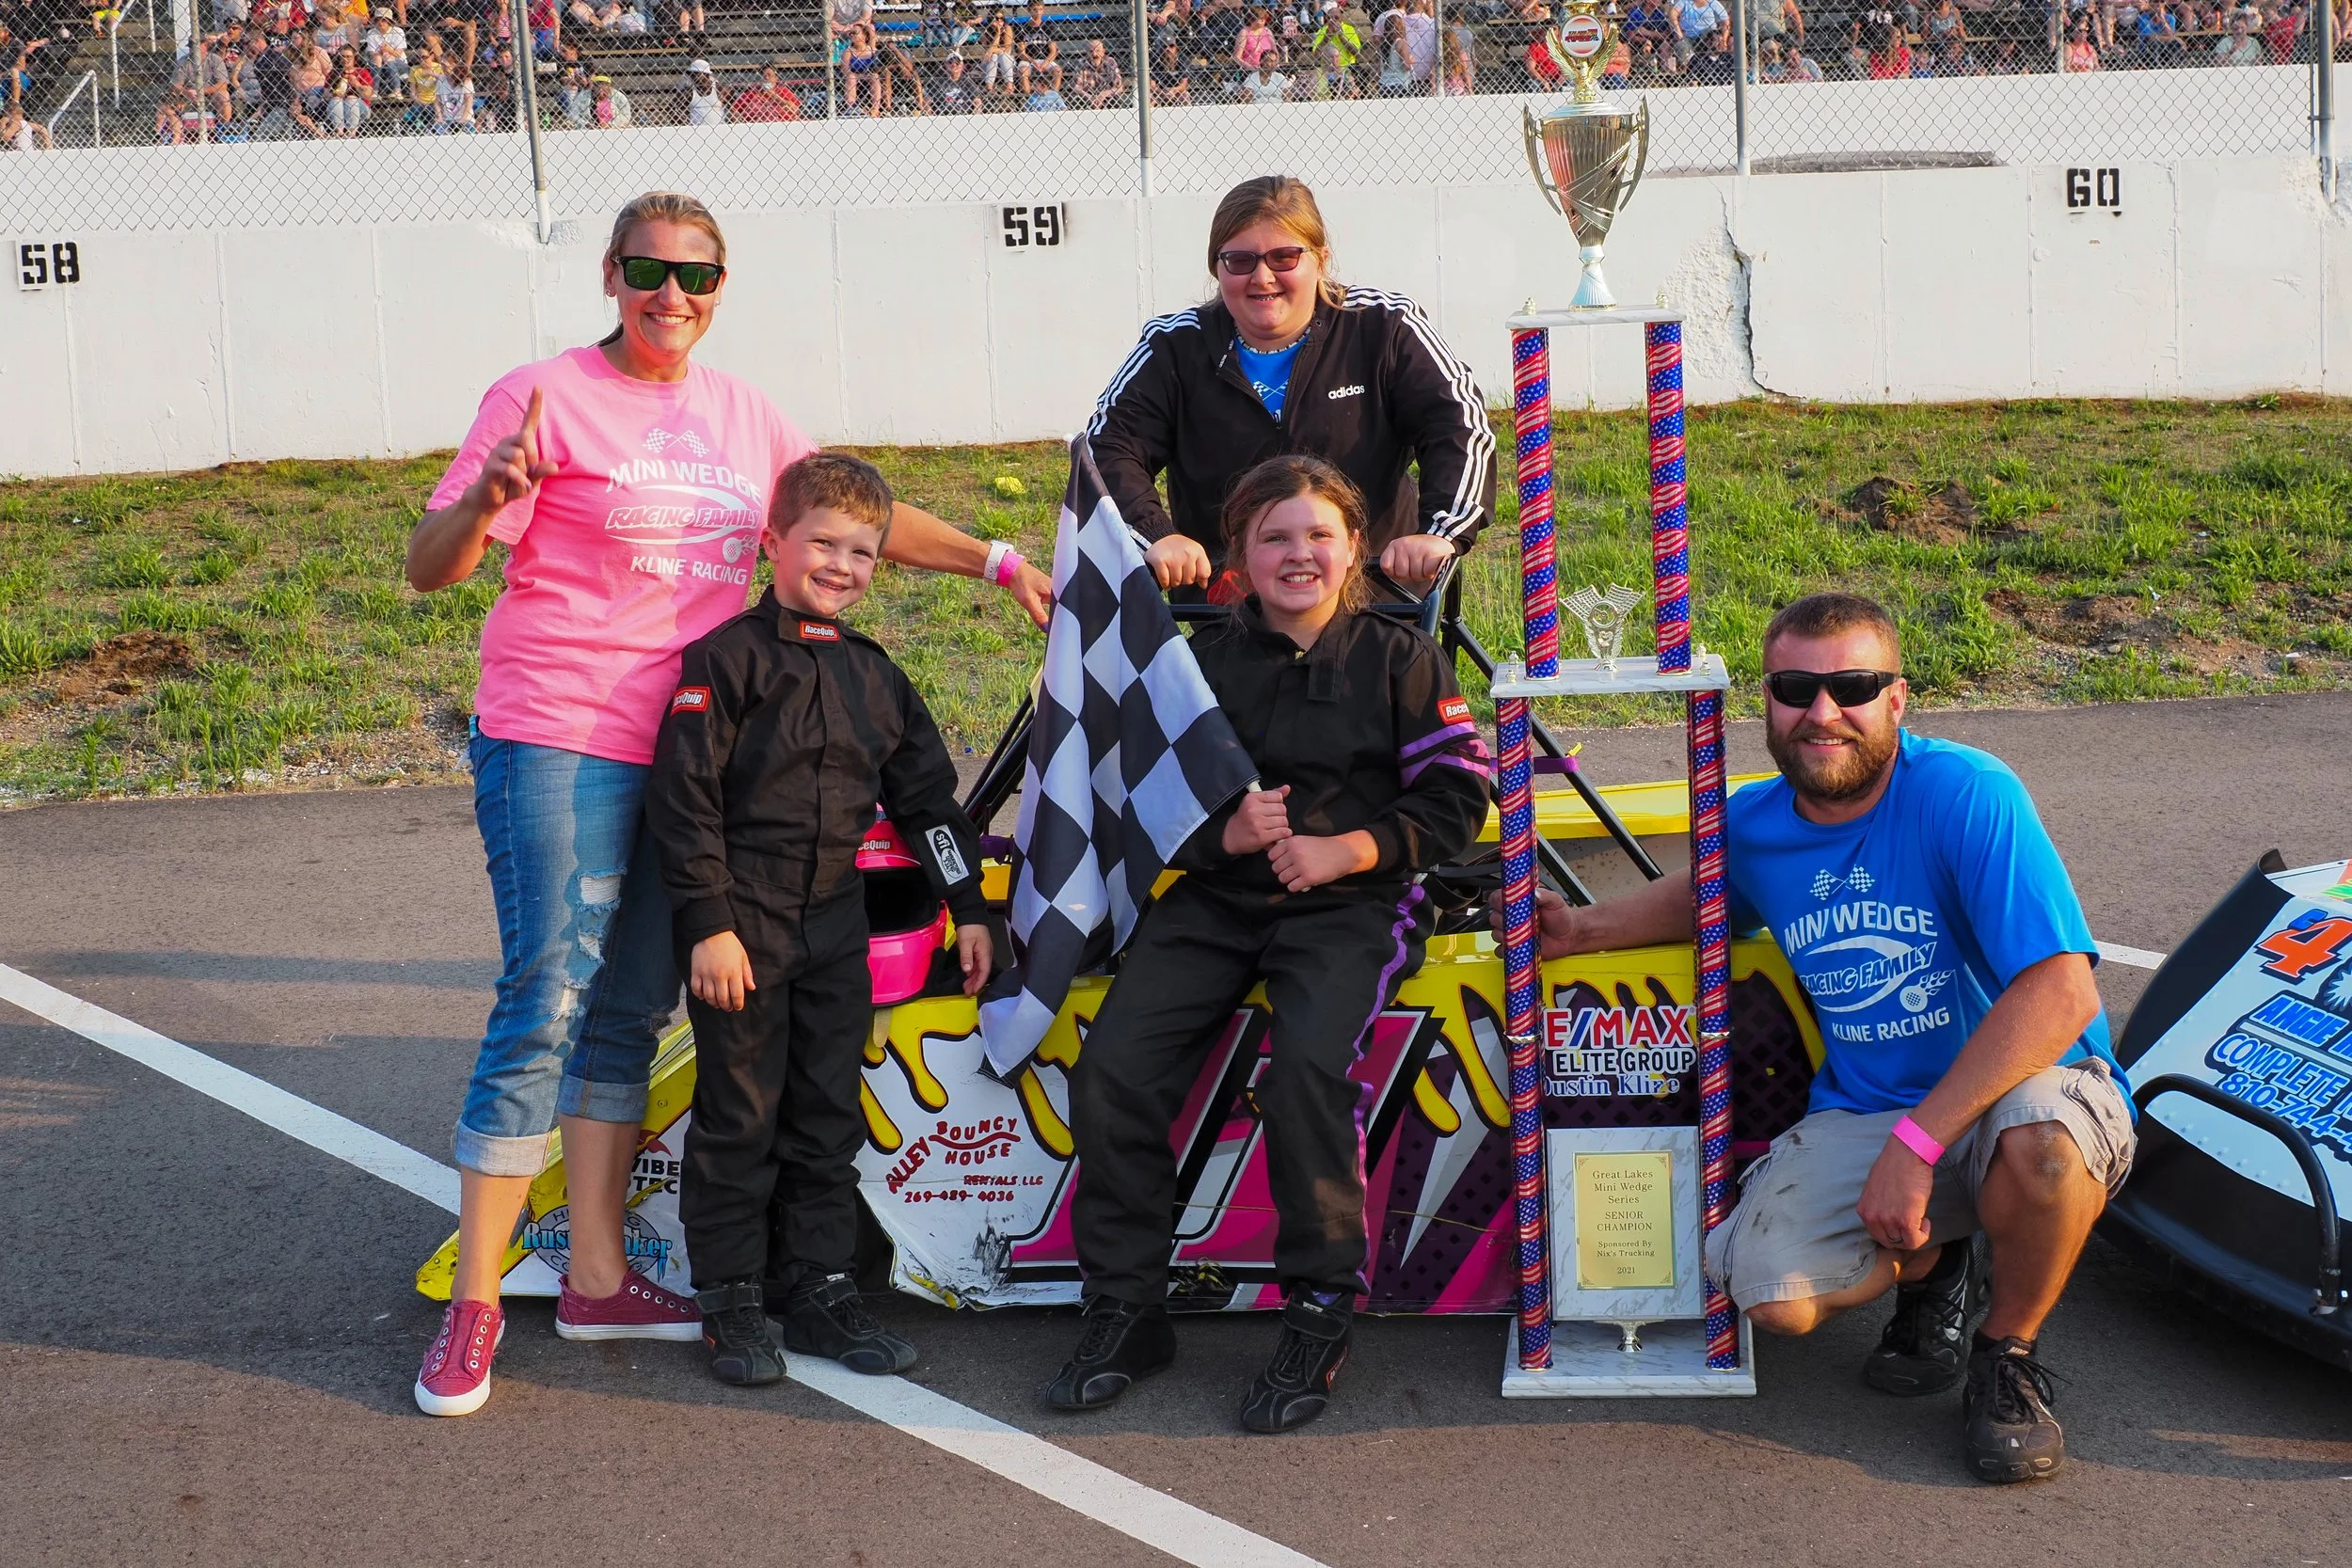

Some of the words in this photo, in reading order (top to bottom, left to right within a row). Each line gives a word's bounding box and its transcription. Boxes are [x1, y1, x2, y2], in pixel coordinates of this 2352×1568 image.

[2066, 167, 2120, 208] 60
[1003, 205, 1059, 246] 59
[21, 242, 80, 284] 58
[1327, 385, 1365, 400] adidas
[606, 459, 666, 493] MINI
[671, 459, 761, 507] WEDGE
[605, 505, 695, 530] RACING
[692, 507, 760, 529] FAMILY
[630, 556, 687, 576] KLINE
[691, 561, 747, 585] RACING
[804, 625, 835, 636] RaceQuip
[1784, 909, 1830, 958] MINI
[1833, 900, 1938, 937] WEDGE
[1799, 967, 1859, 996] RACING
[1859, 941, 1938, 989] FAMILY
[1832, 1022, 1873, 1042] KLINE
[1877, 1006, 1950, 1041] RACING
[2249, 995, 2349, 1047] ANGIE
[1556, 1051, 1616, 1073] ELITE
[1623, 1050, 1693, 1072] GROUP
[2214, 1034, 2350, 1106] COMPLETE
[1545, 1076, 1611, 1096] ustin
[936, 1116, 1017, 1141] BOUNCY
[885, 1136, 931, 1195] ALLEY
[945, 1143, 1011, 1165] HOUSE
[1592, 1170, 1620, 1180] Great
[1624, 1169, 1653, 1179] Lakes
[1594, 1182, 1616, 1192] Mini
[1620, 1182, 1653, 1193] Wedge
[1608, 1195, 1640, 1204] Series
[1597, 1222, 1652, 1232] CHAMPION
[1605, 1211, 1644, 1220] SENIOR
[1597, 1240, 1640, 1249] Sponsored
[1642, 1240, 1652, 1248] By
[1618, 1249, 1655, 1258] Trucking
[1617, 1266, 1635, 1275] 2021
